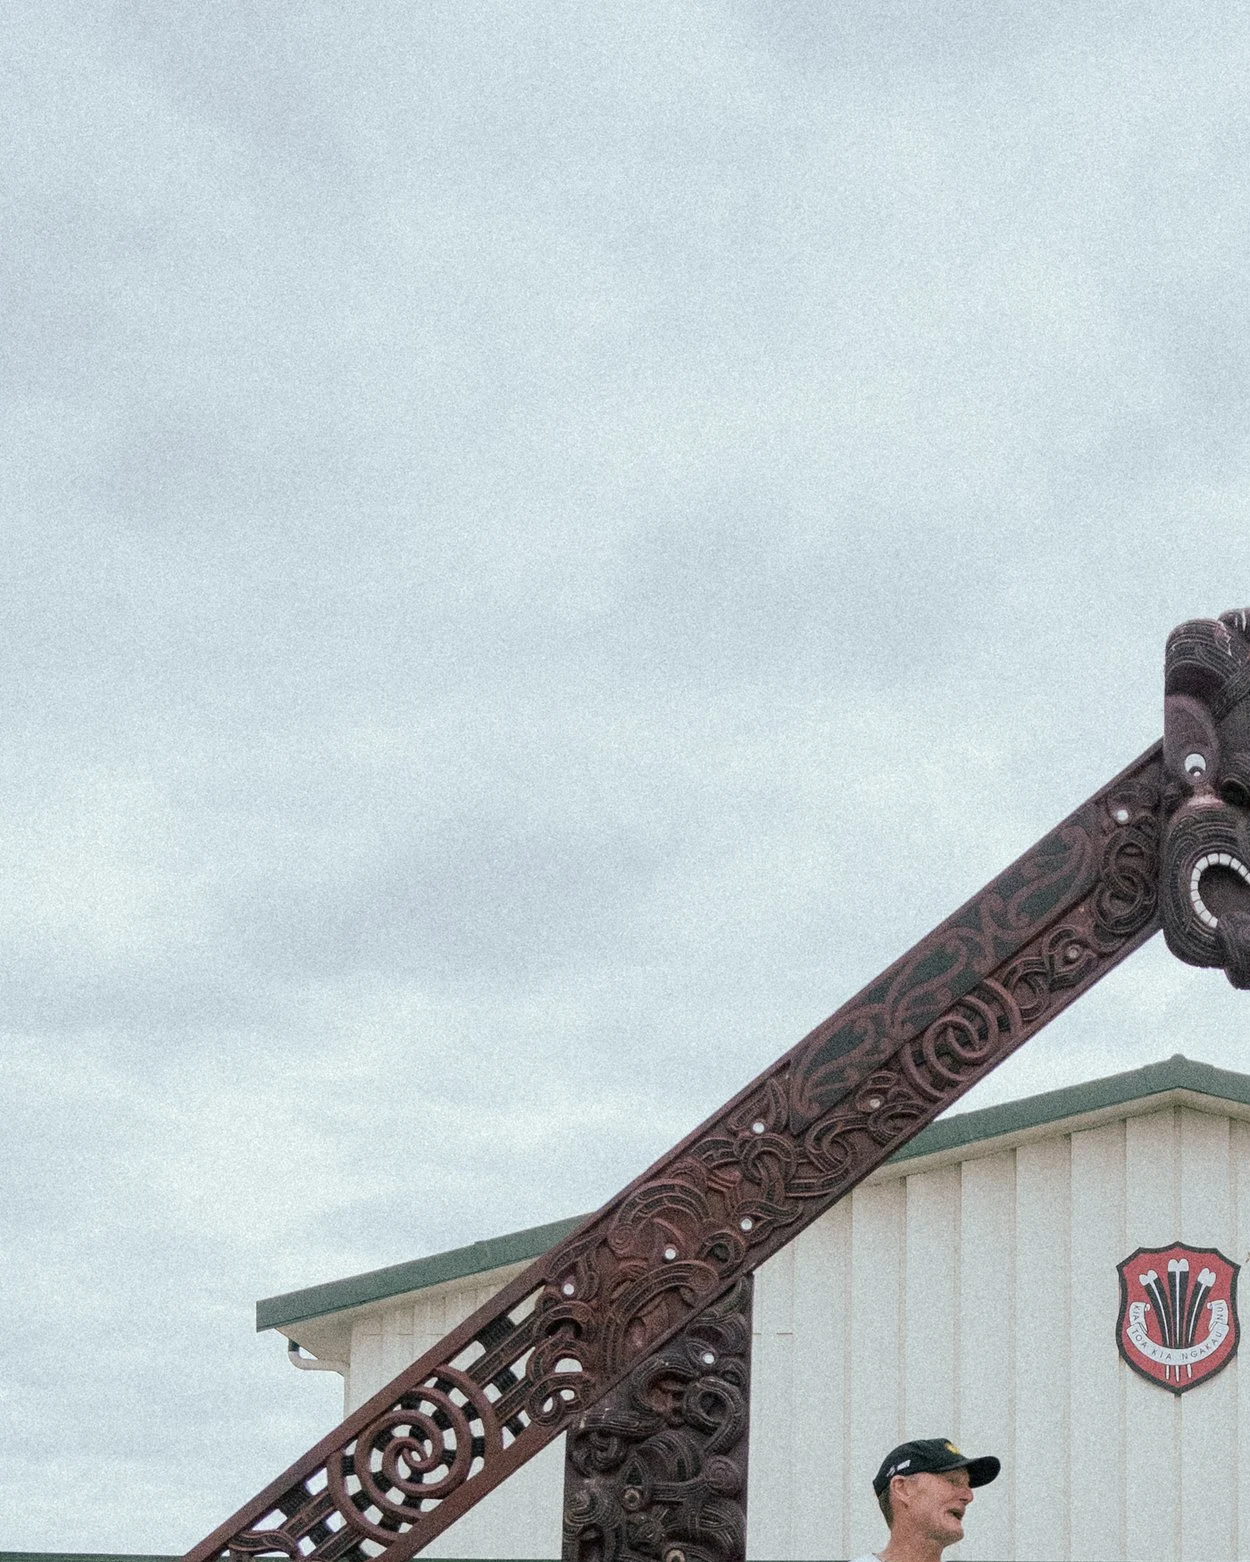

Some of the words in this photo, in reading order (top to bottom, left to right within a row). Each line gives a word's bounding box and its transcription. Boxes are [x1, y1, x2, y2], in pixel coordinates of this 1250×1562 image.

[1133, 1304, 1141, 1321] KIA
[1131, 1328, 1148, 1348] TOA
[1181, 1330, 1223, 1360] NGAKAU
[1151, 1348, 1172, 1361] KIA
